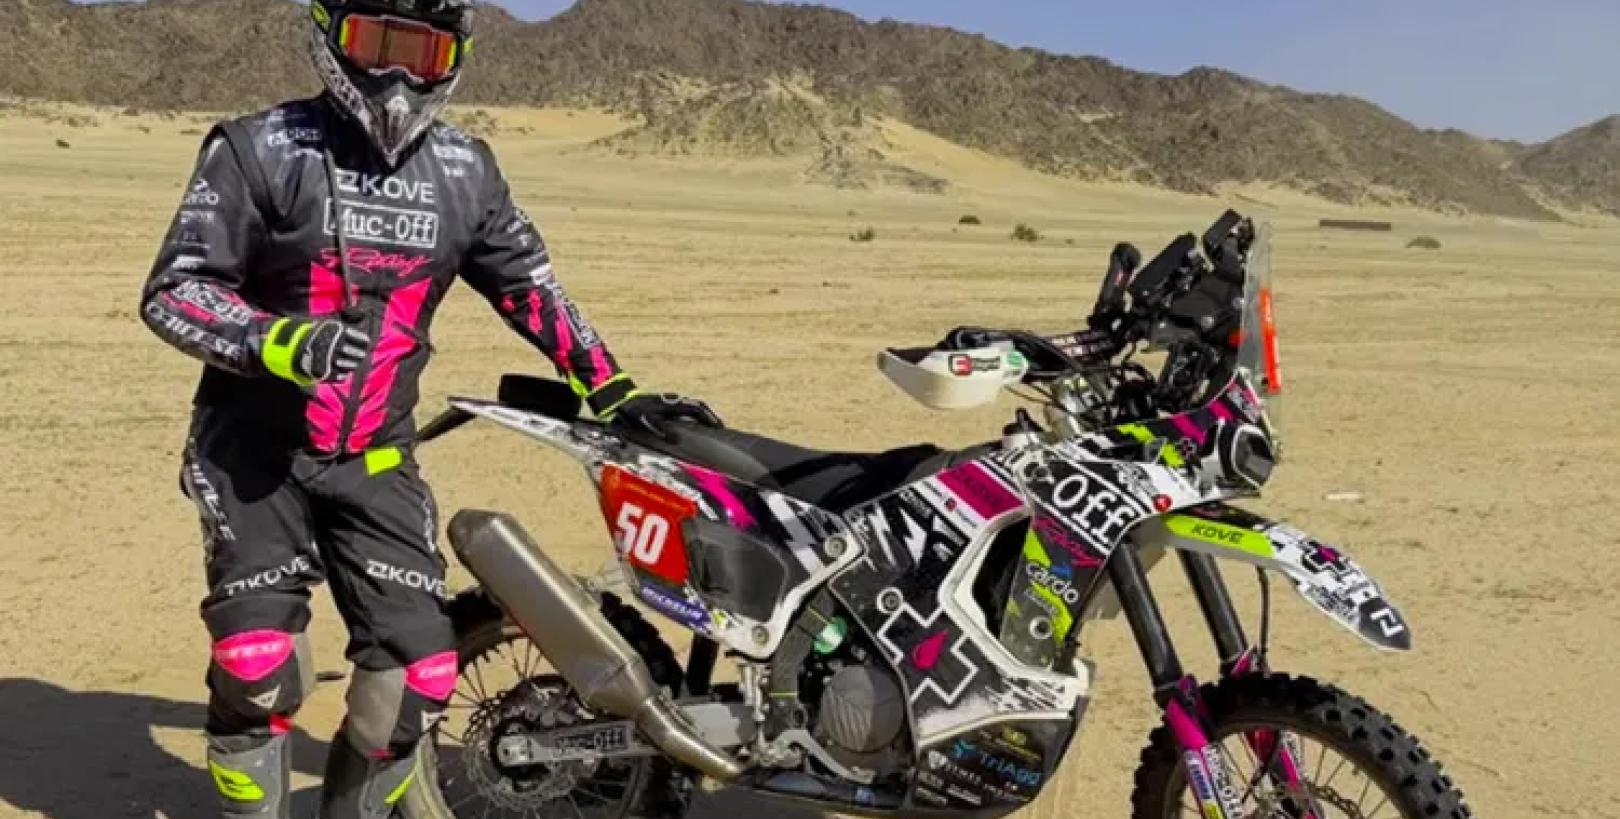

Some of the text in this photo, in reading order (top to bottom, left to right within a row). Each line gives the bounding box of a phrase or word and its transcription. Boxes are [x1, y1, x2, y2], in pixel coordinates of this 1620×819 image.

[362, 174, 434, 203] KOVE
[615, 502, 669, 564] 50
[1191, 524, 1243, 543] KOVE
